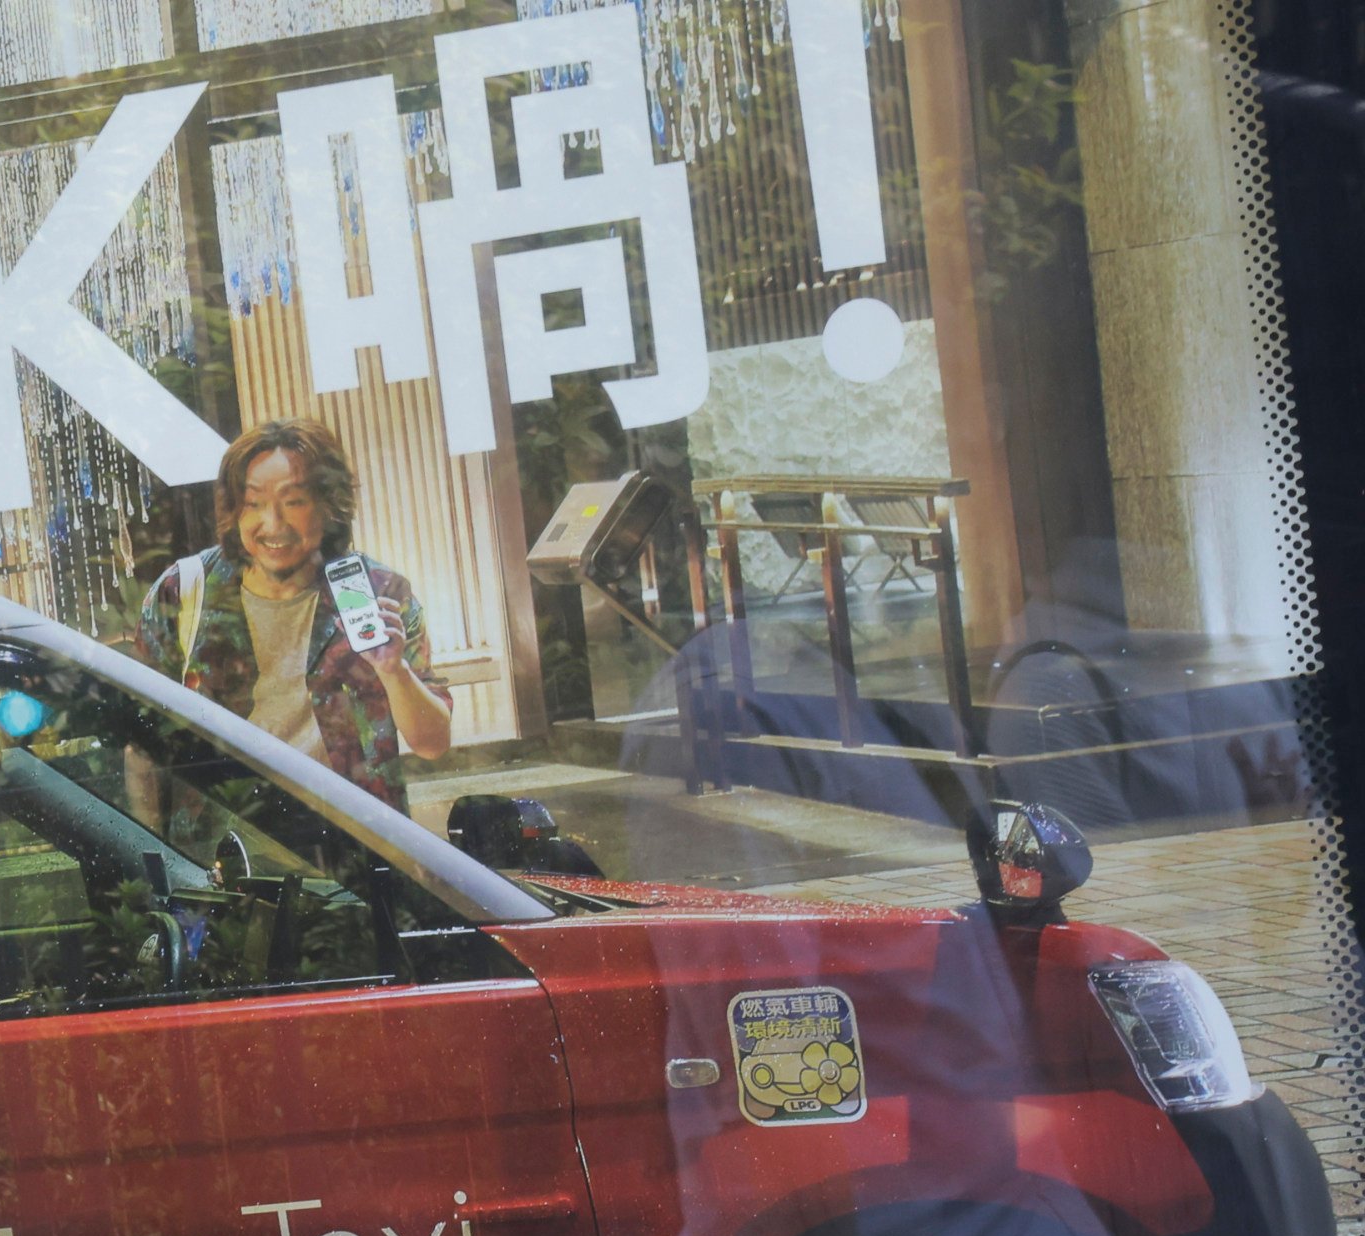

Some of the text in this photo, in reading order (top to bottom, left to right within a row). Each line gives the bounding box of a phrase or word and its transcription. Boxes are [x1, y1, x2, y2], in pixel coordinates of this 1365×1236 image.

[740, 994, 839, 1018] 燃氣車輛
[744, 1016, 841, 1040] 環境清新
[790, 1101, 817, 1111] LPG
